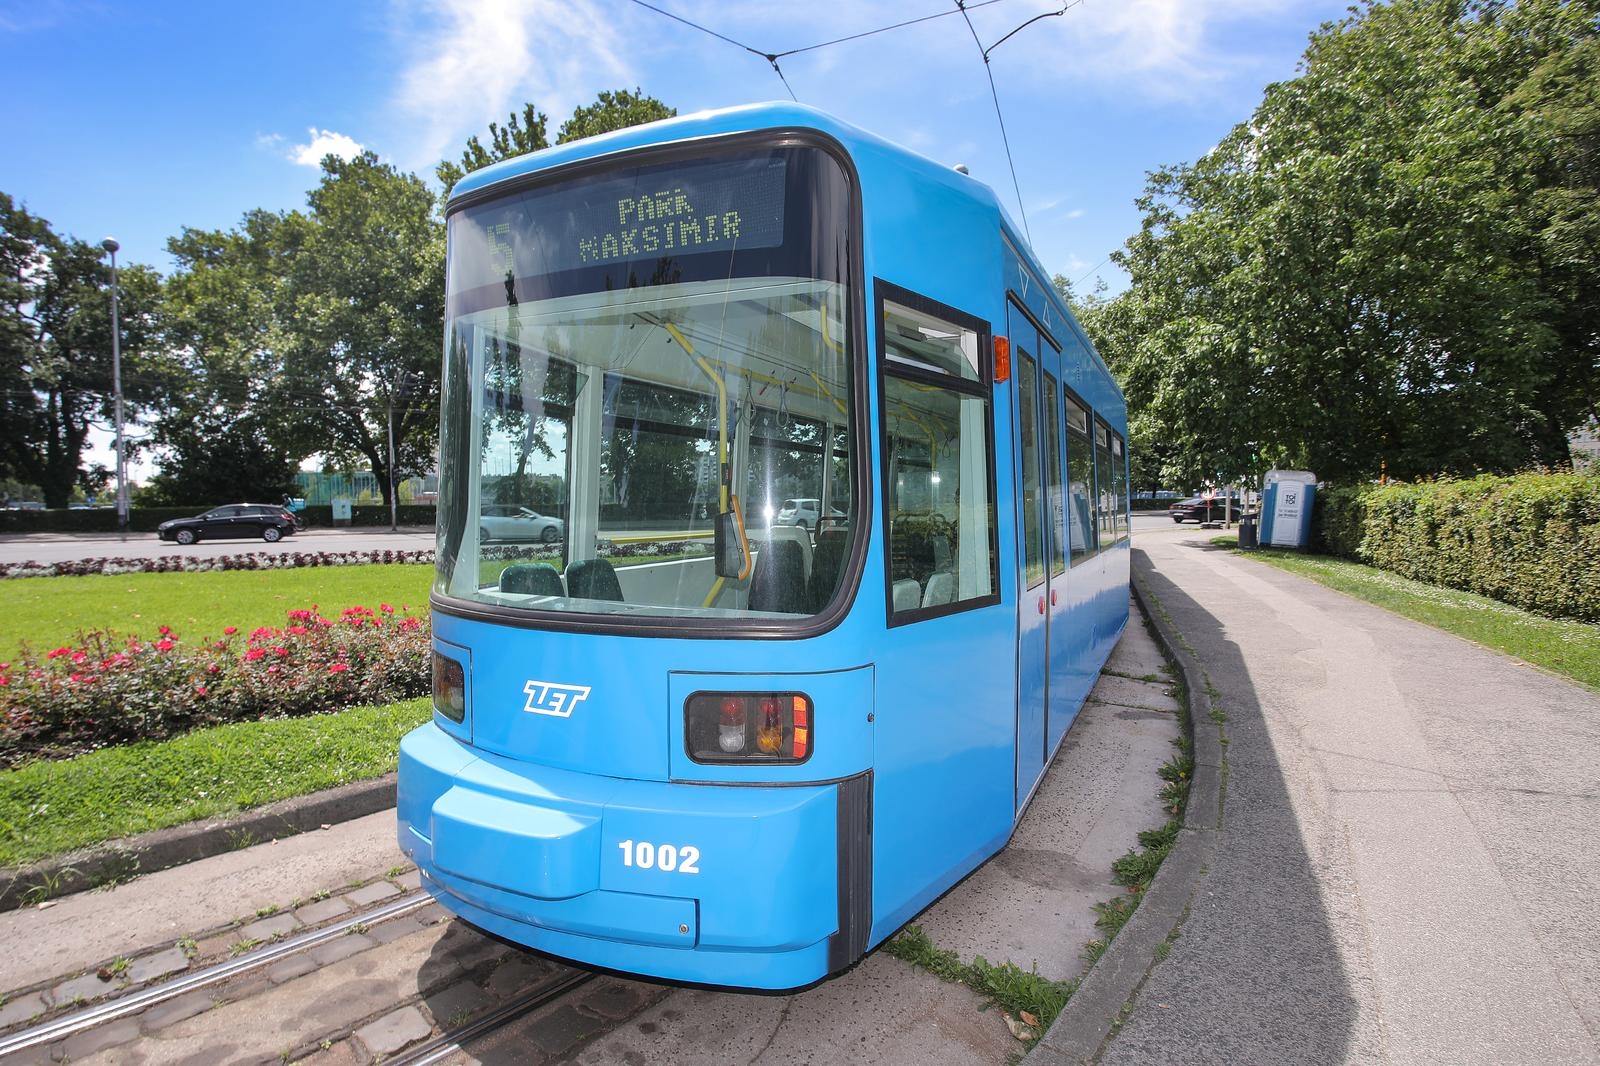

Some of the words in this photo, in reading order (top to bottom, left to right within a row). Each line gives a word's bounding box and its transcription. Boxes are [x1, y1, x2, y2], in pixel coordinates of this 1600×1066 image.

[487, 223, 514, 277] 5
[579, 211, 742, 262] MAKSIMIR
[523, 679, 592, 718] ZET
[618, 839, 700, 873] 1002
